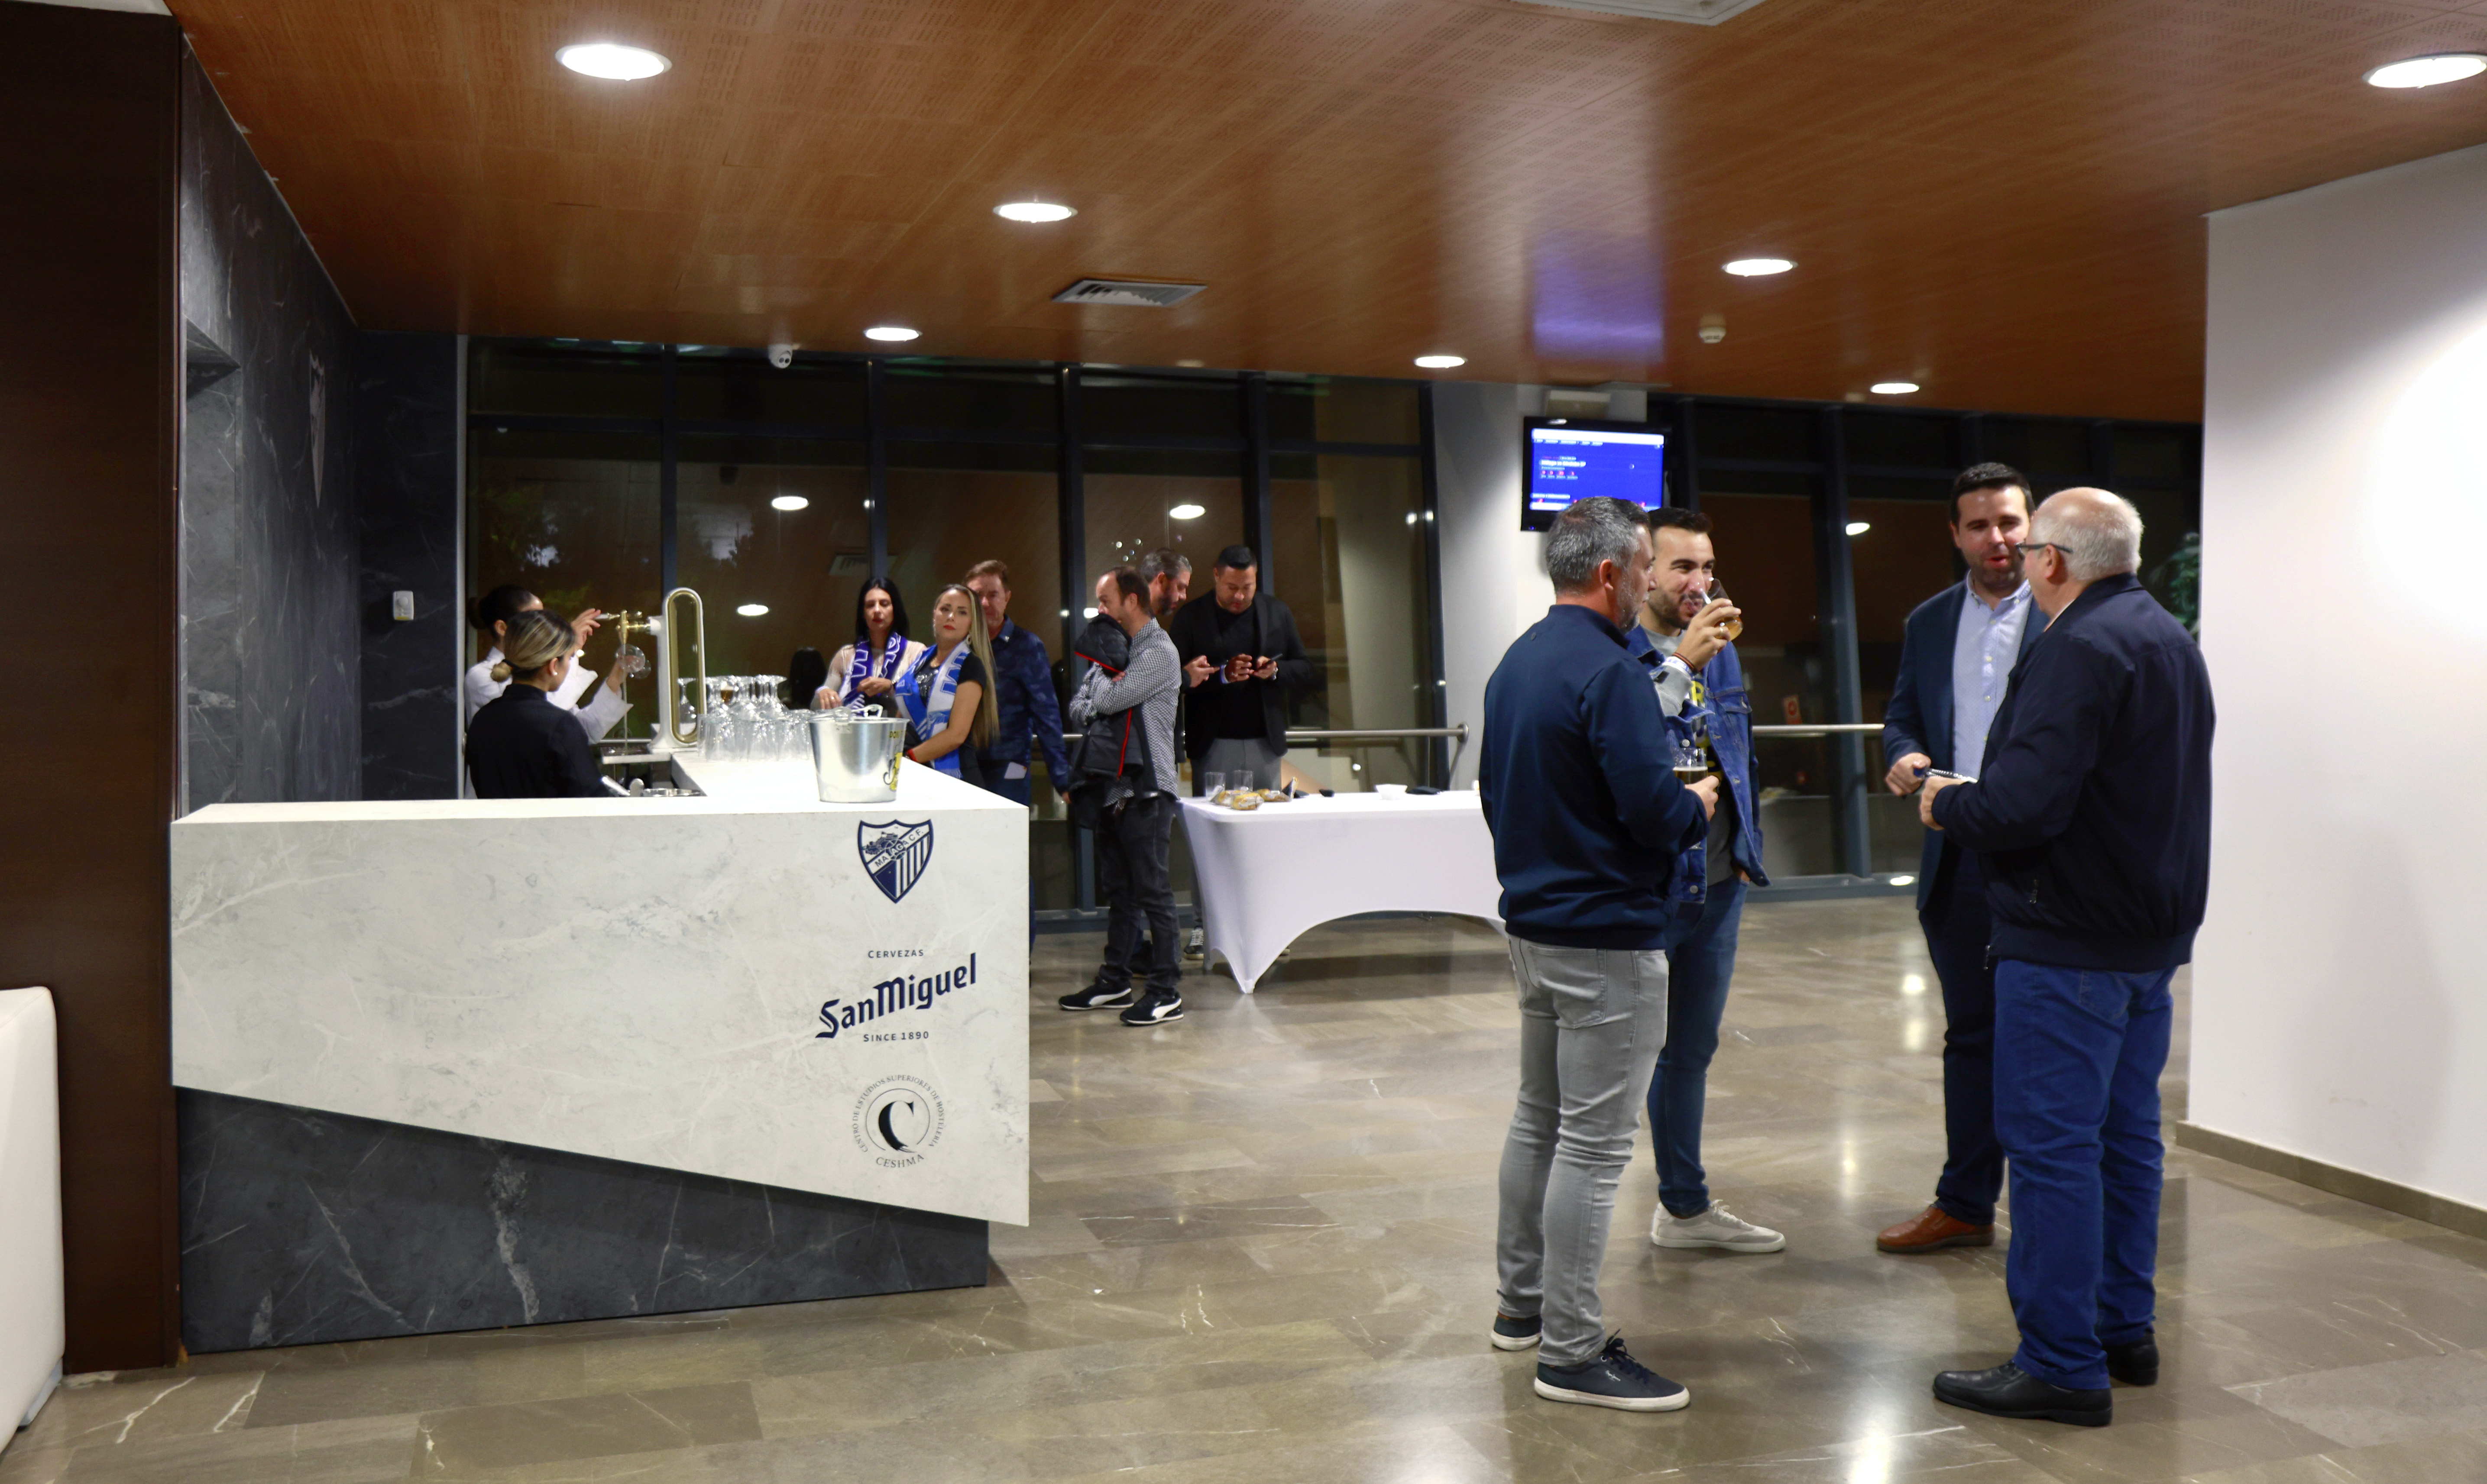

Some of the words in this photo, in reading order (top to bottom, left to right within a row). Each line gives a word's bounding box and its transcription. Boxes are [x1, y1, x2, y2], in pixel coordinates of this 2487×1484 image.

[868, 949, 924, 958] CERVEZAS
[863, 1033, 897, 1042] SINCE
[901, 1031, 929, 1040] 1890
[886, 1074, 932, 1092] SUPERIORES
[855, 1078, 886, 1109] ESTUDIOS
[930, 1090, 940, 1101] DE
[852, 1111, 860, 1121] DE
[852, 1123, 868, 1152] CENTRO
[876, 1154, 924, 1168] CESHMA
